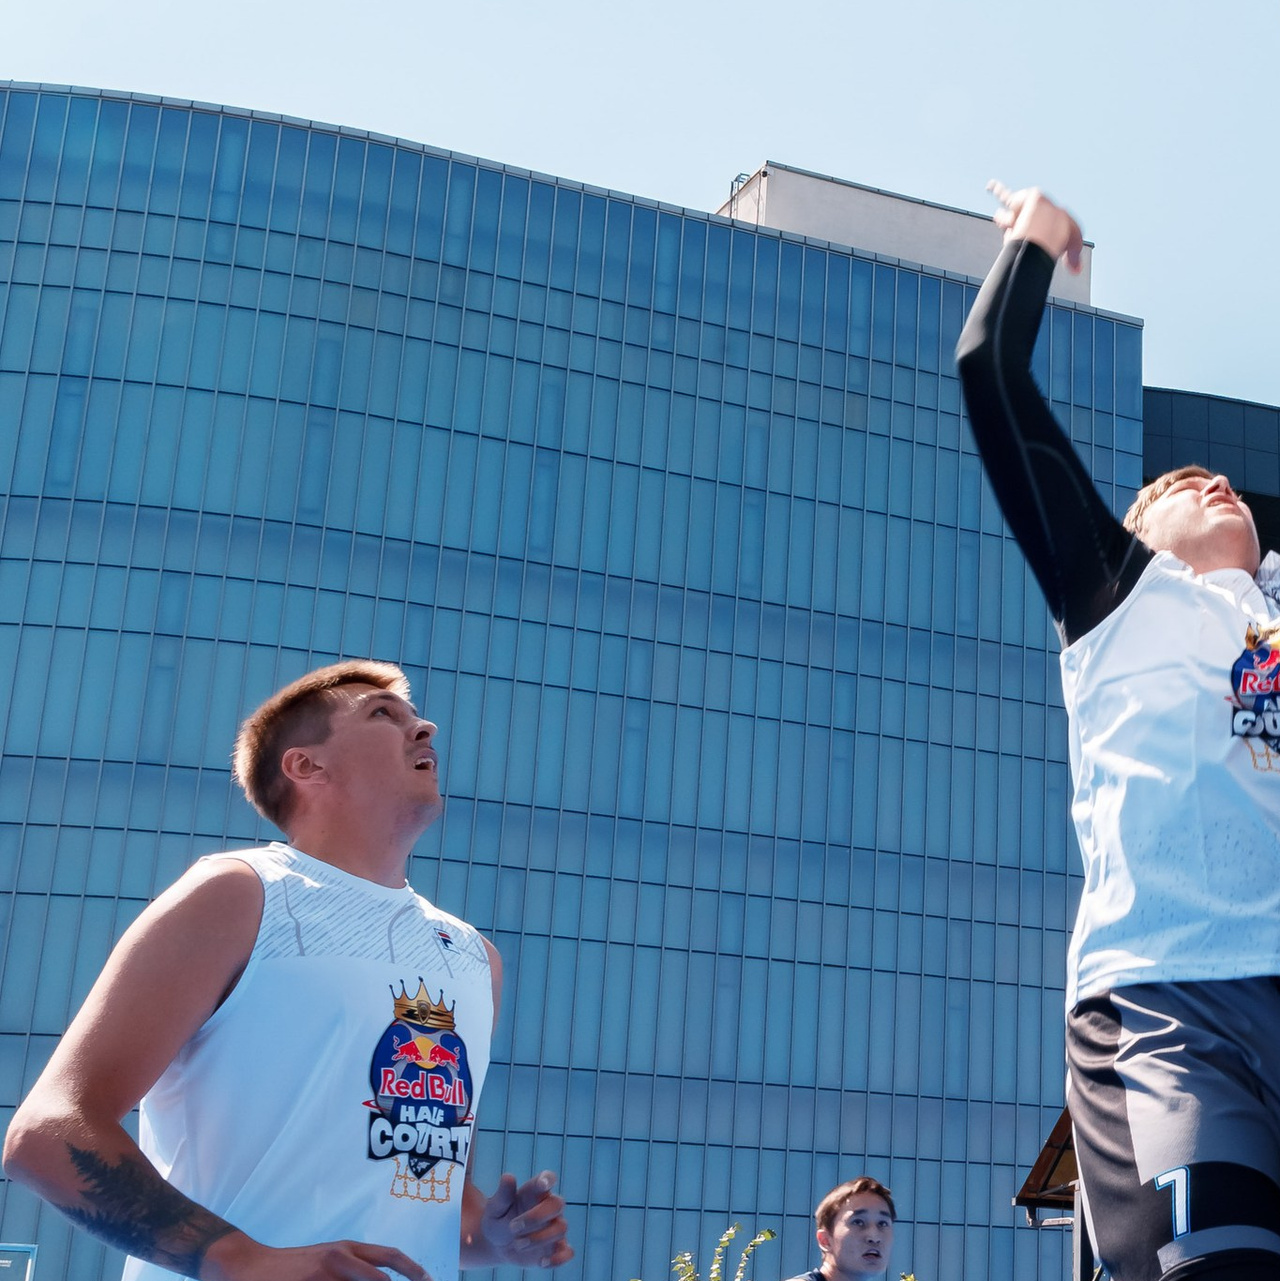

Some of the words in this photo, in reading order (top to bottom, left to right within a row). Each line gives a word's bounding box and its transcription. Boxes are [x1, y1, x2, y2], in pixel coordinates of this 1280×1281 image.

[379, 1067, 427, 1099] Red
[427, 1073, 466, 1107] Bull
[400, 1105, 445, 1126] HALF
[369, 1117, 471, 1164] COURT
[1153, 1165, 1191, 1241] 1
